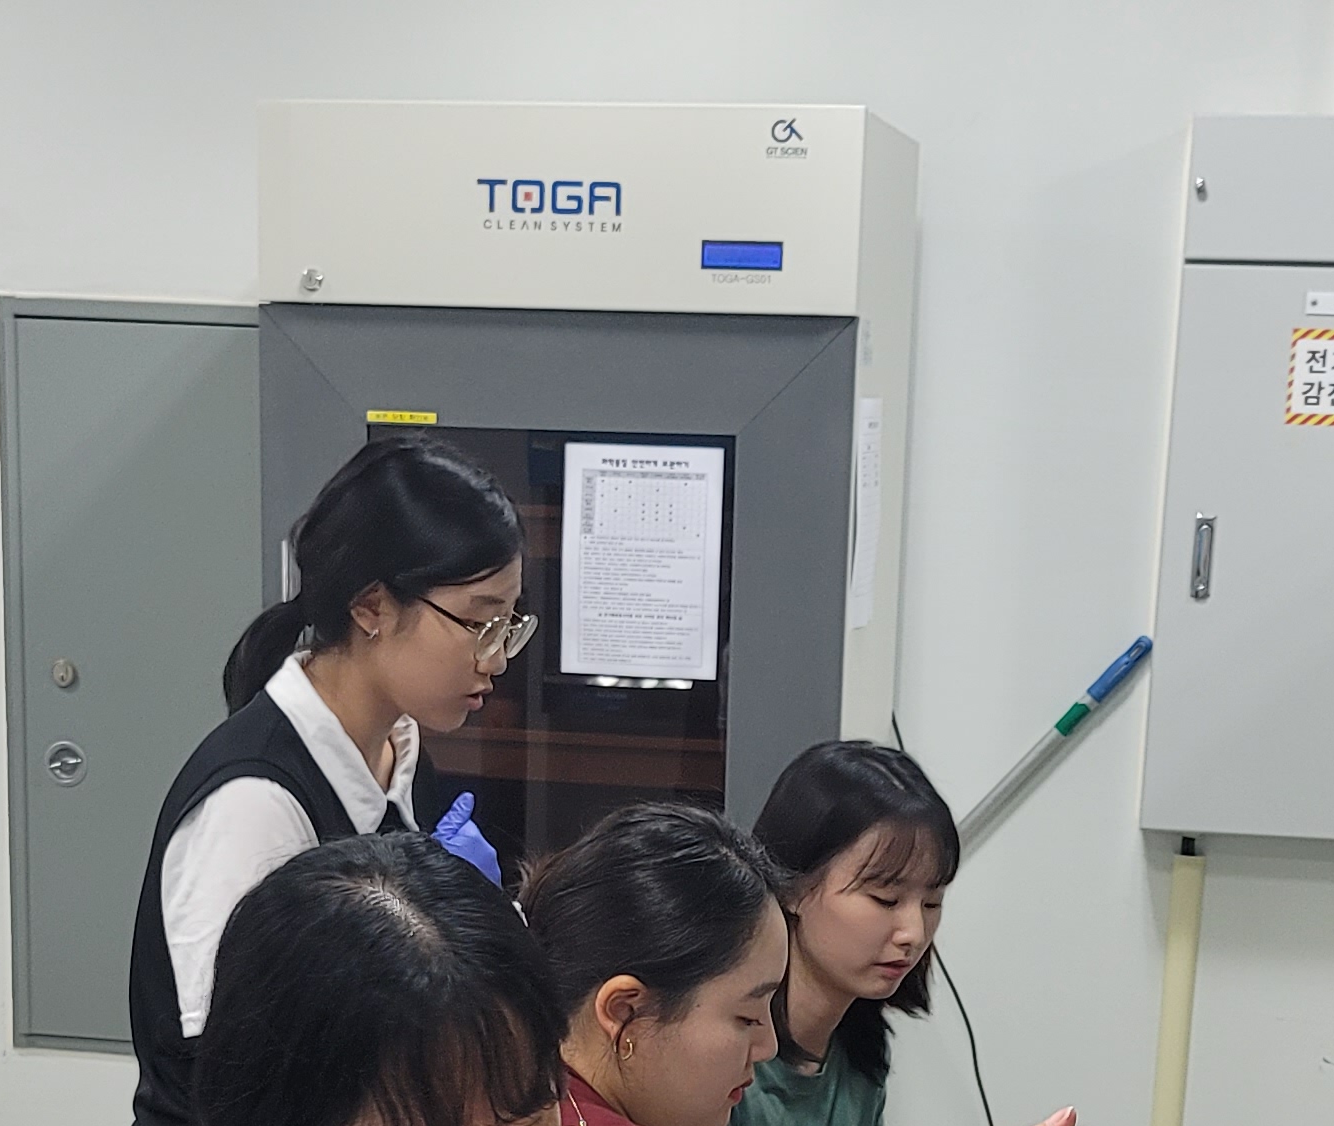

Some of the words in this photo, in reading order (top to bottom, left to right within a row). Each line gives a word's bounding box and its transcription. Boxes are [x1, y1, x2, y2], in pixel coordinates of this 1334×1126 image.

[477, 178, 622, 216] TOGA
[483, 219, 543, 231] CLEAN
[550, 220, 622, 232] SYSTEM
